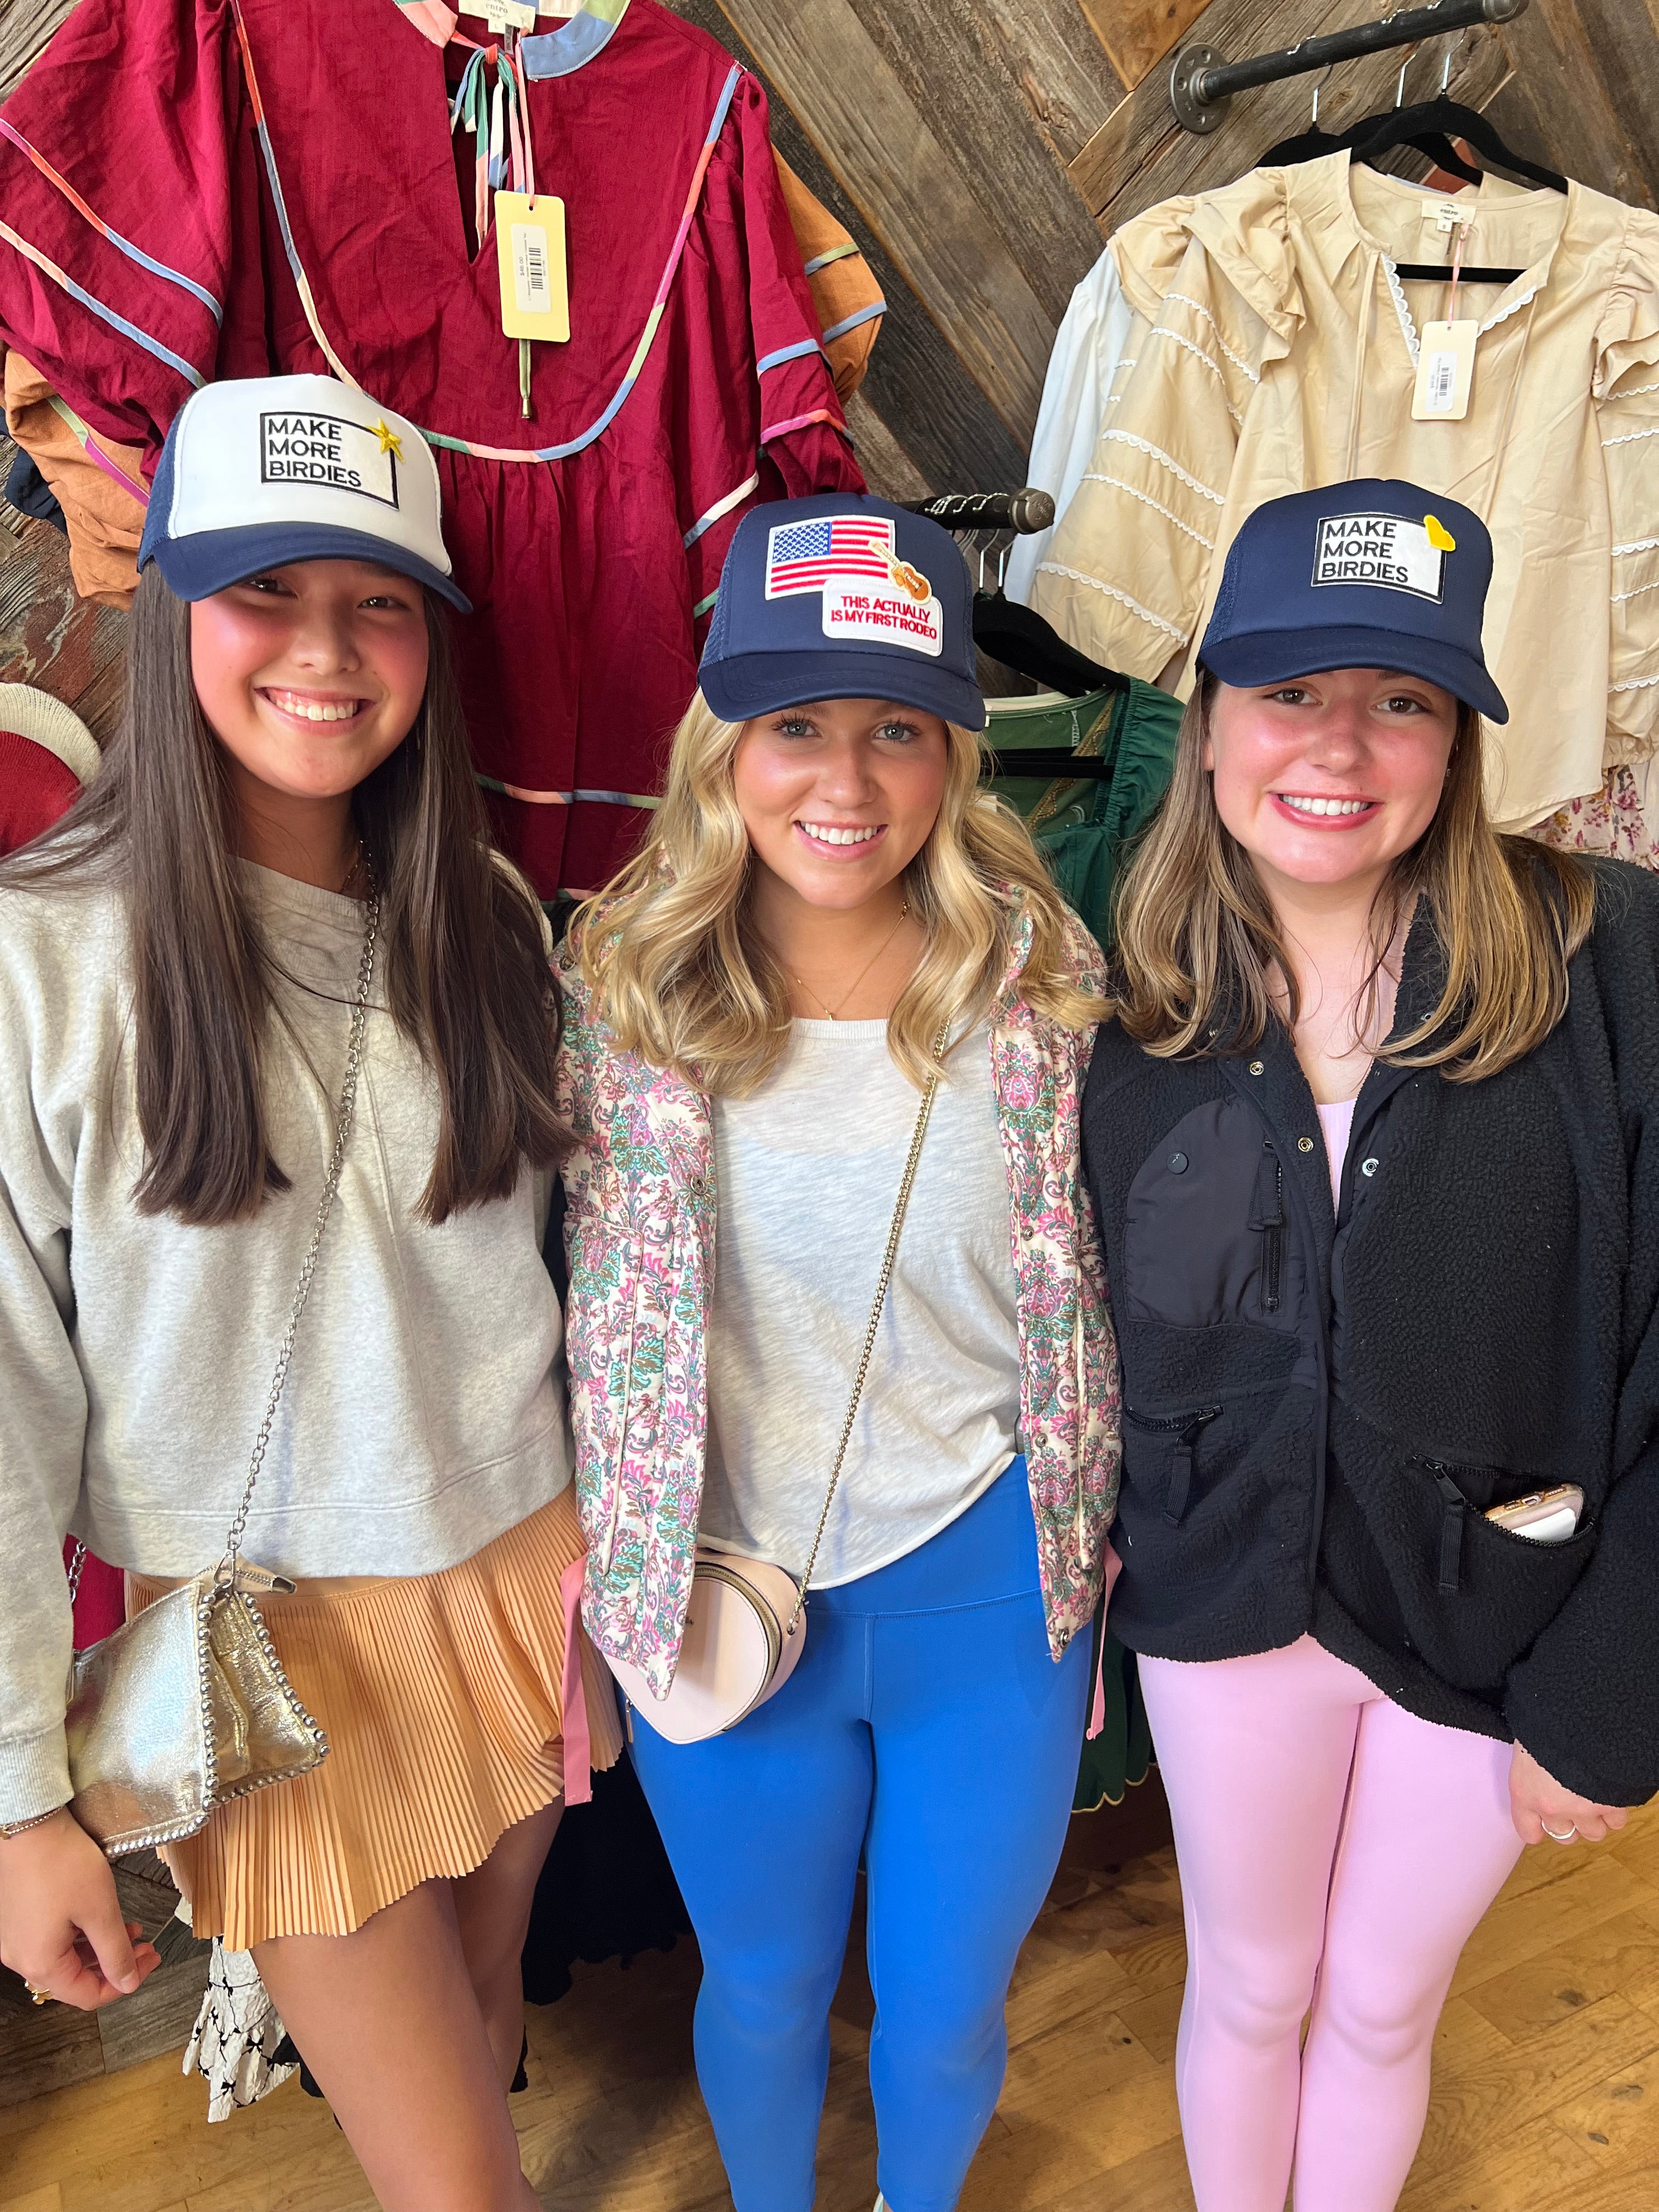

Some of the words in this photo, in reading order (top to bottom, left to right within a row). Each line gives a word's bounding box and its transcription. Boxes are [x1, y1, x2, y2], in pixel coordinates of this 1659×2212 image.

[268, 418, 342, 441] MAKE
[269, 438, 341, 462] MORE
[269, 460, 362, 487] BIRDIES
[1325, 521, 1397, 539] MAKE
[1323, 540, 1393, 559] MORE
[1322, 561, 1408, 583] BIRDIES
[840, 595, 870, 610] THIS
[873, 598, 930, 623] ACTUALLY
[831, 610, 843, 622] IS
[845, 610, 865, 623] MY
[865, 611, 899, 628] FIRST
[900, 617, 937, 640] RODEO
